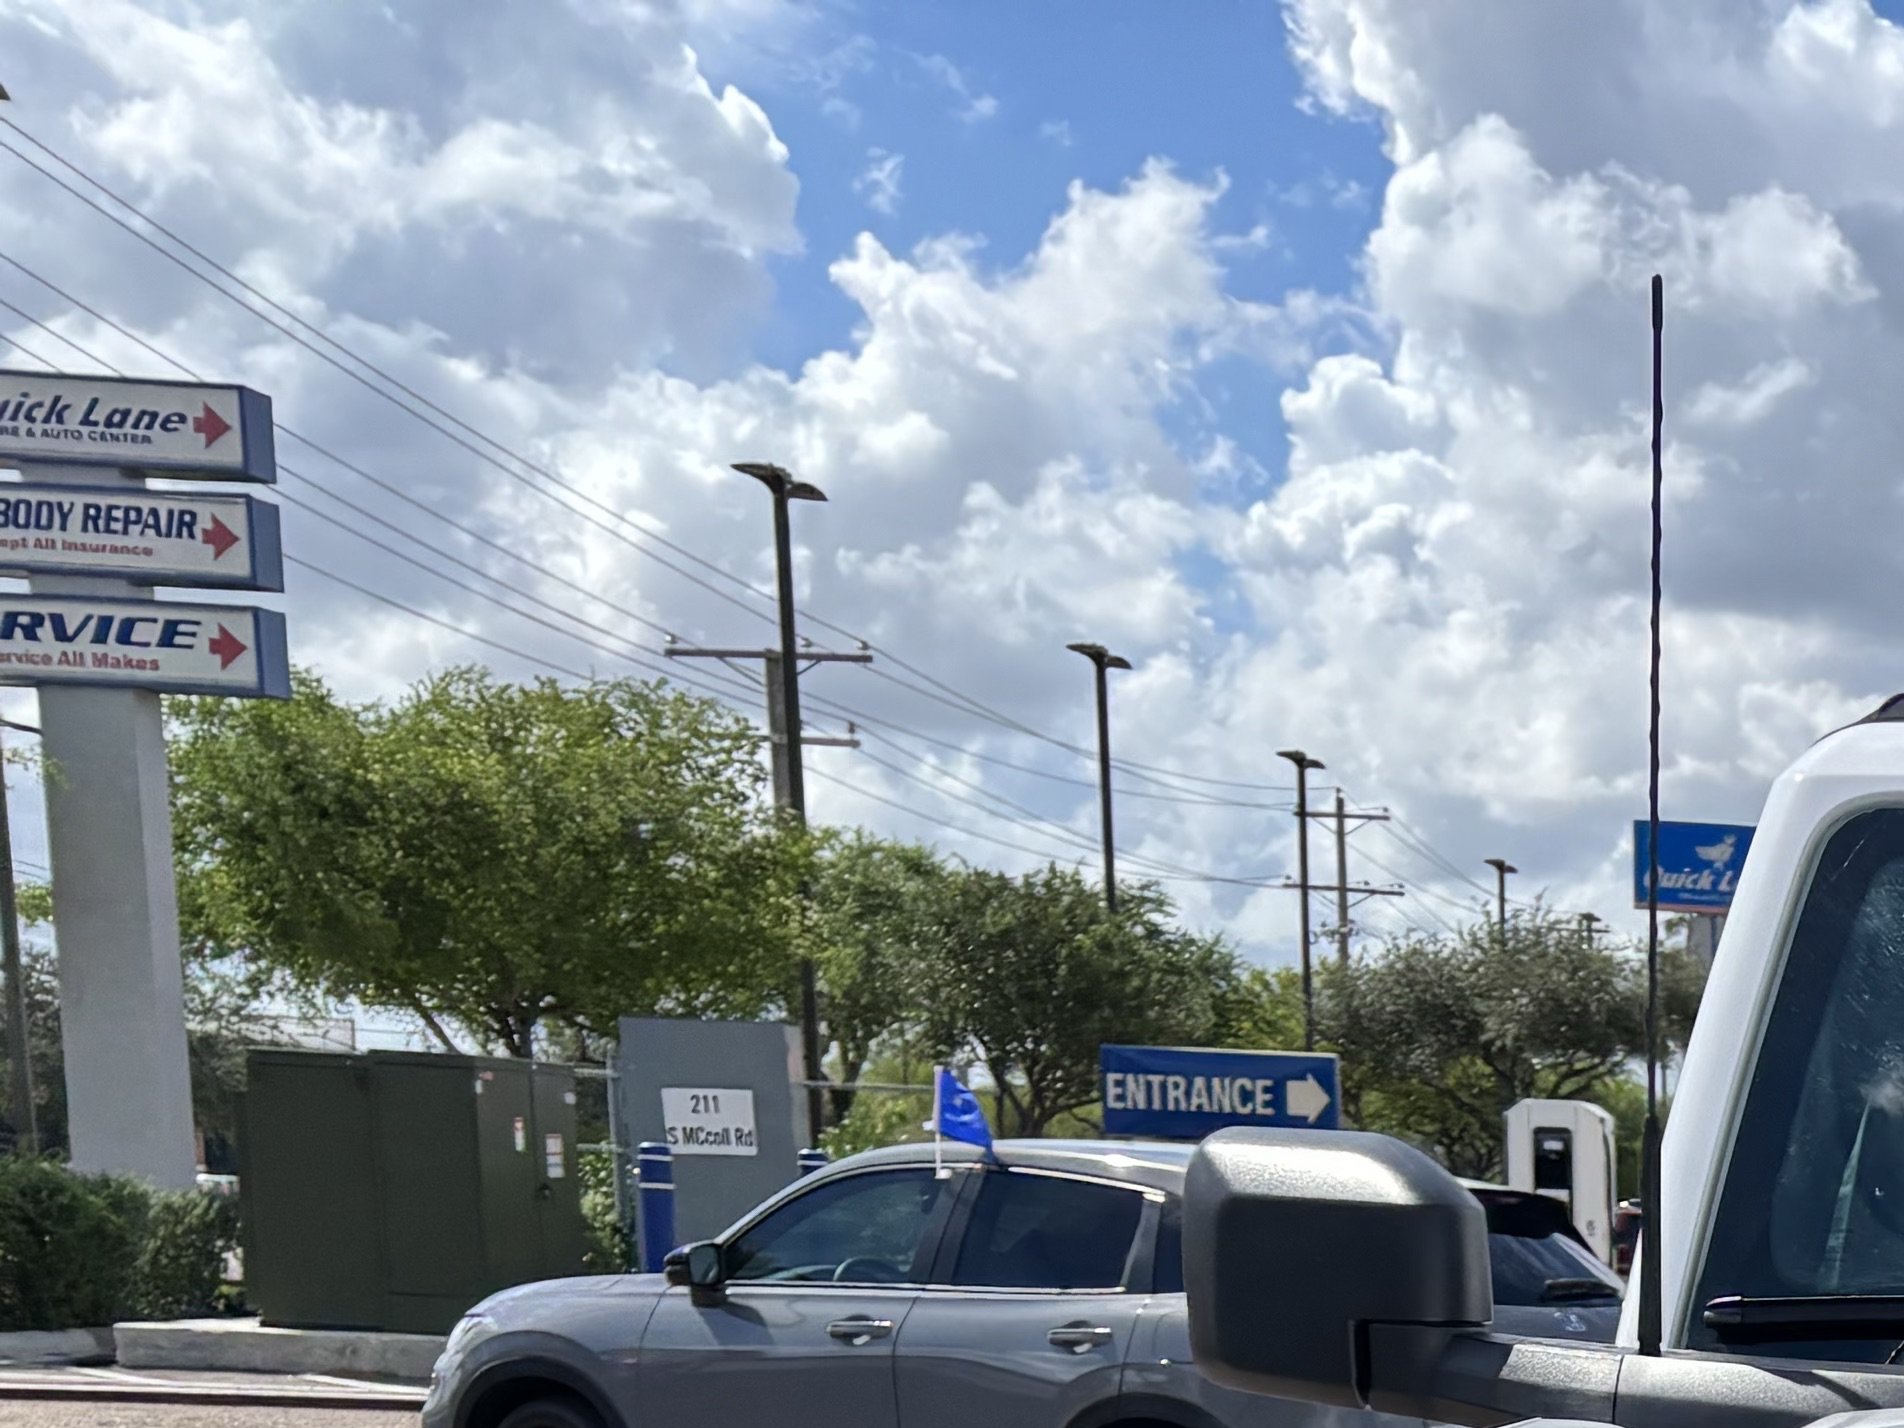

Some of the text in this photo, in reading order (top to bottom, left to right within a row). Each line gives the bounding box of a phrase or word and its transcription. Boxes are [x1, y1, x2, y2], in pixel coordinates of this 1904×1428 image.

[78, 397, 187, 432] Lane
[41, 428, 83, 441] AUTO
[88, 430, 153, 444] CENTER
[0, 499, 196, 540] BODY REPAIR
[33, 537, 56, 549] All
[62, 540, 153, 557] Insurance
[0, 611, 202, 650] RVICE
[57, 651, 85, 668] All
[91, 652, 160, 671] Makes
[690, 1094, 720, 1114] 211
[1106, 1072, 1275, 1116] ENTRANCE
[667, 1126, 679, 1145] S
